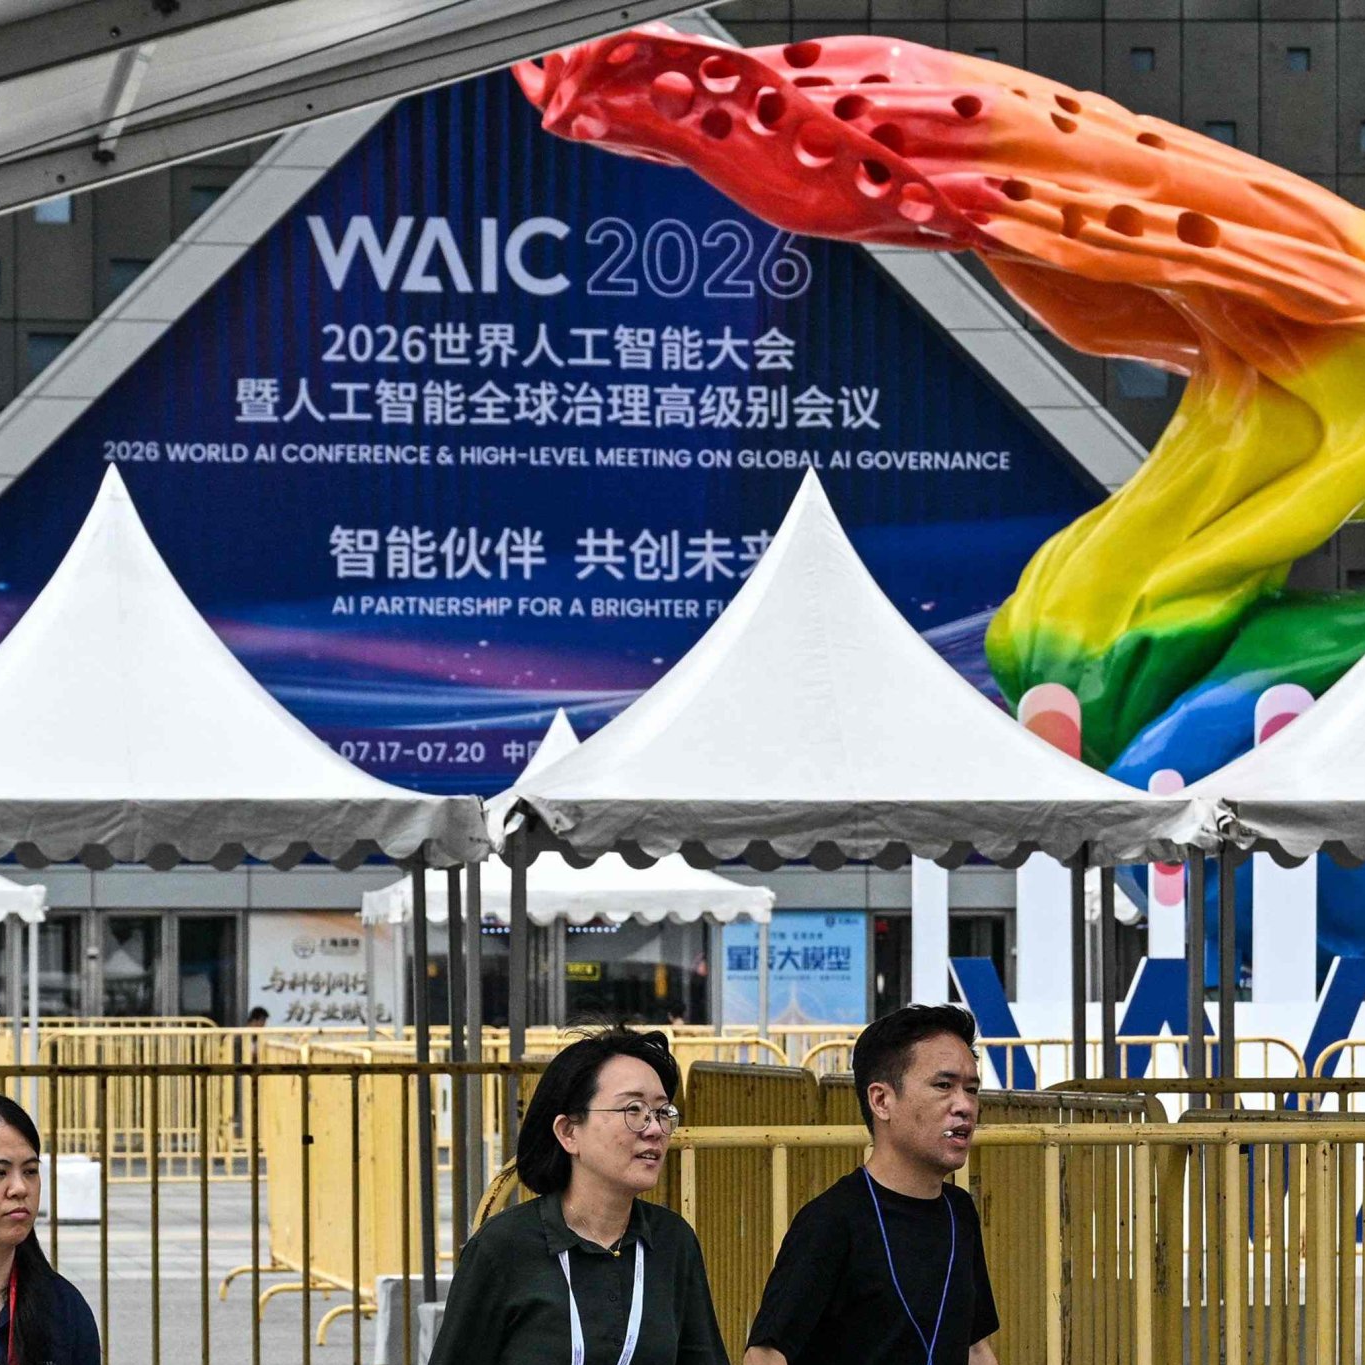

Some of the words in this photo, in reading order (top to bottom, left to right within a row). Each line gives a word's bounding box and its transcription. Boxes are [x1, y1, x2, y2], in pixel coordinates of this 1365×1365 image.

[307, 216, 570, 296] WAIC
[585, 217, 812, 299] 2026
[322, 323, 795, 371] 2026世界人工智能大会
[234, 378, 882, 431] 暨人工智能全球治理高级别会议
[103, 441, 160, 461] 2026
[165, 443, 248, 463] WORLD
[253, 444, 276, 462] AI
[281, 443, 431, 465] CONFERENCE
[435, 445, 454, 464] &
[460, 446, 590, 467] HIGH-LEVEL
[595, 447, 692, 468] MEETING
[697, 449, 732, 468] ON
[737, 450, 824, 470] GLOBAL
[829, 451, 851, 469] AI
[856, 451, 1011, 471] GOVERNANCE
[329, 524, 547, 580] 智能伙伴
[331, 596, 354, 615] AI
[360, 596, 512, 616] PARTNERSHIP
[517, 598, 563, 617] FOR
[568, 598, 586, 617] A
[591, 598, 700, 618] BRIGHTER
[323, 740, 486, 764] 07.17-07.20
